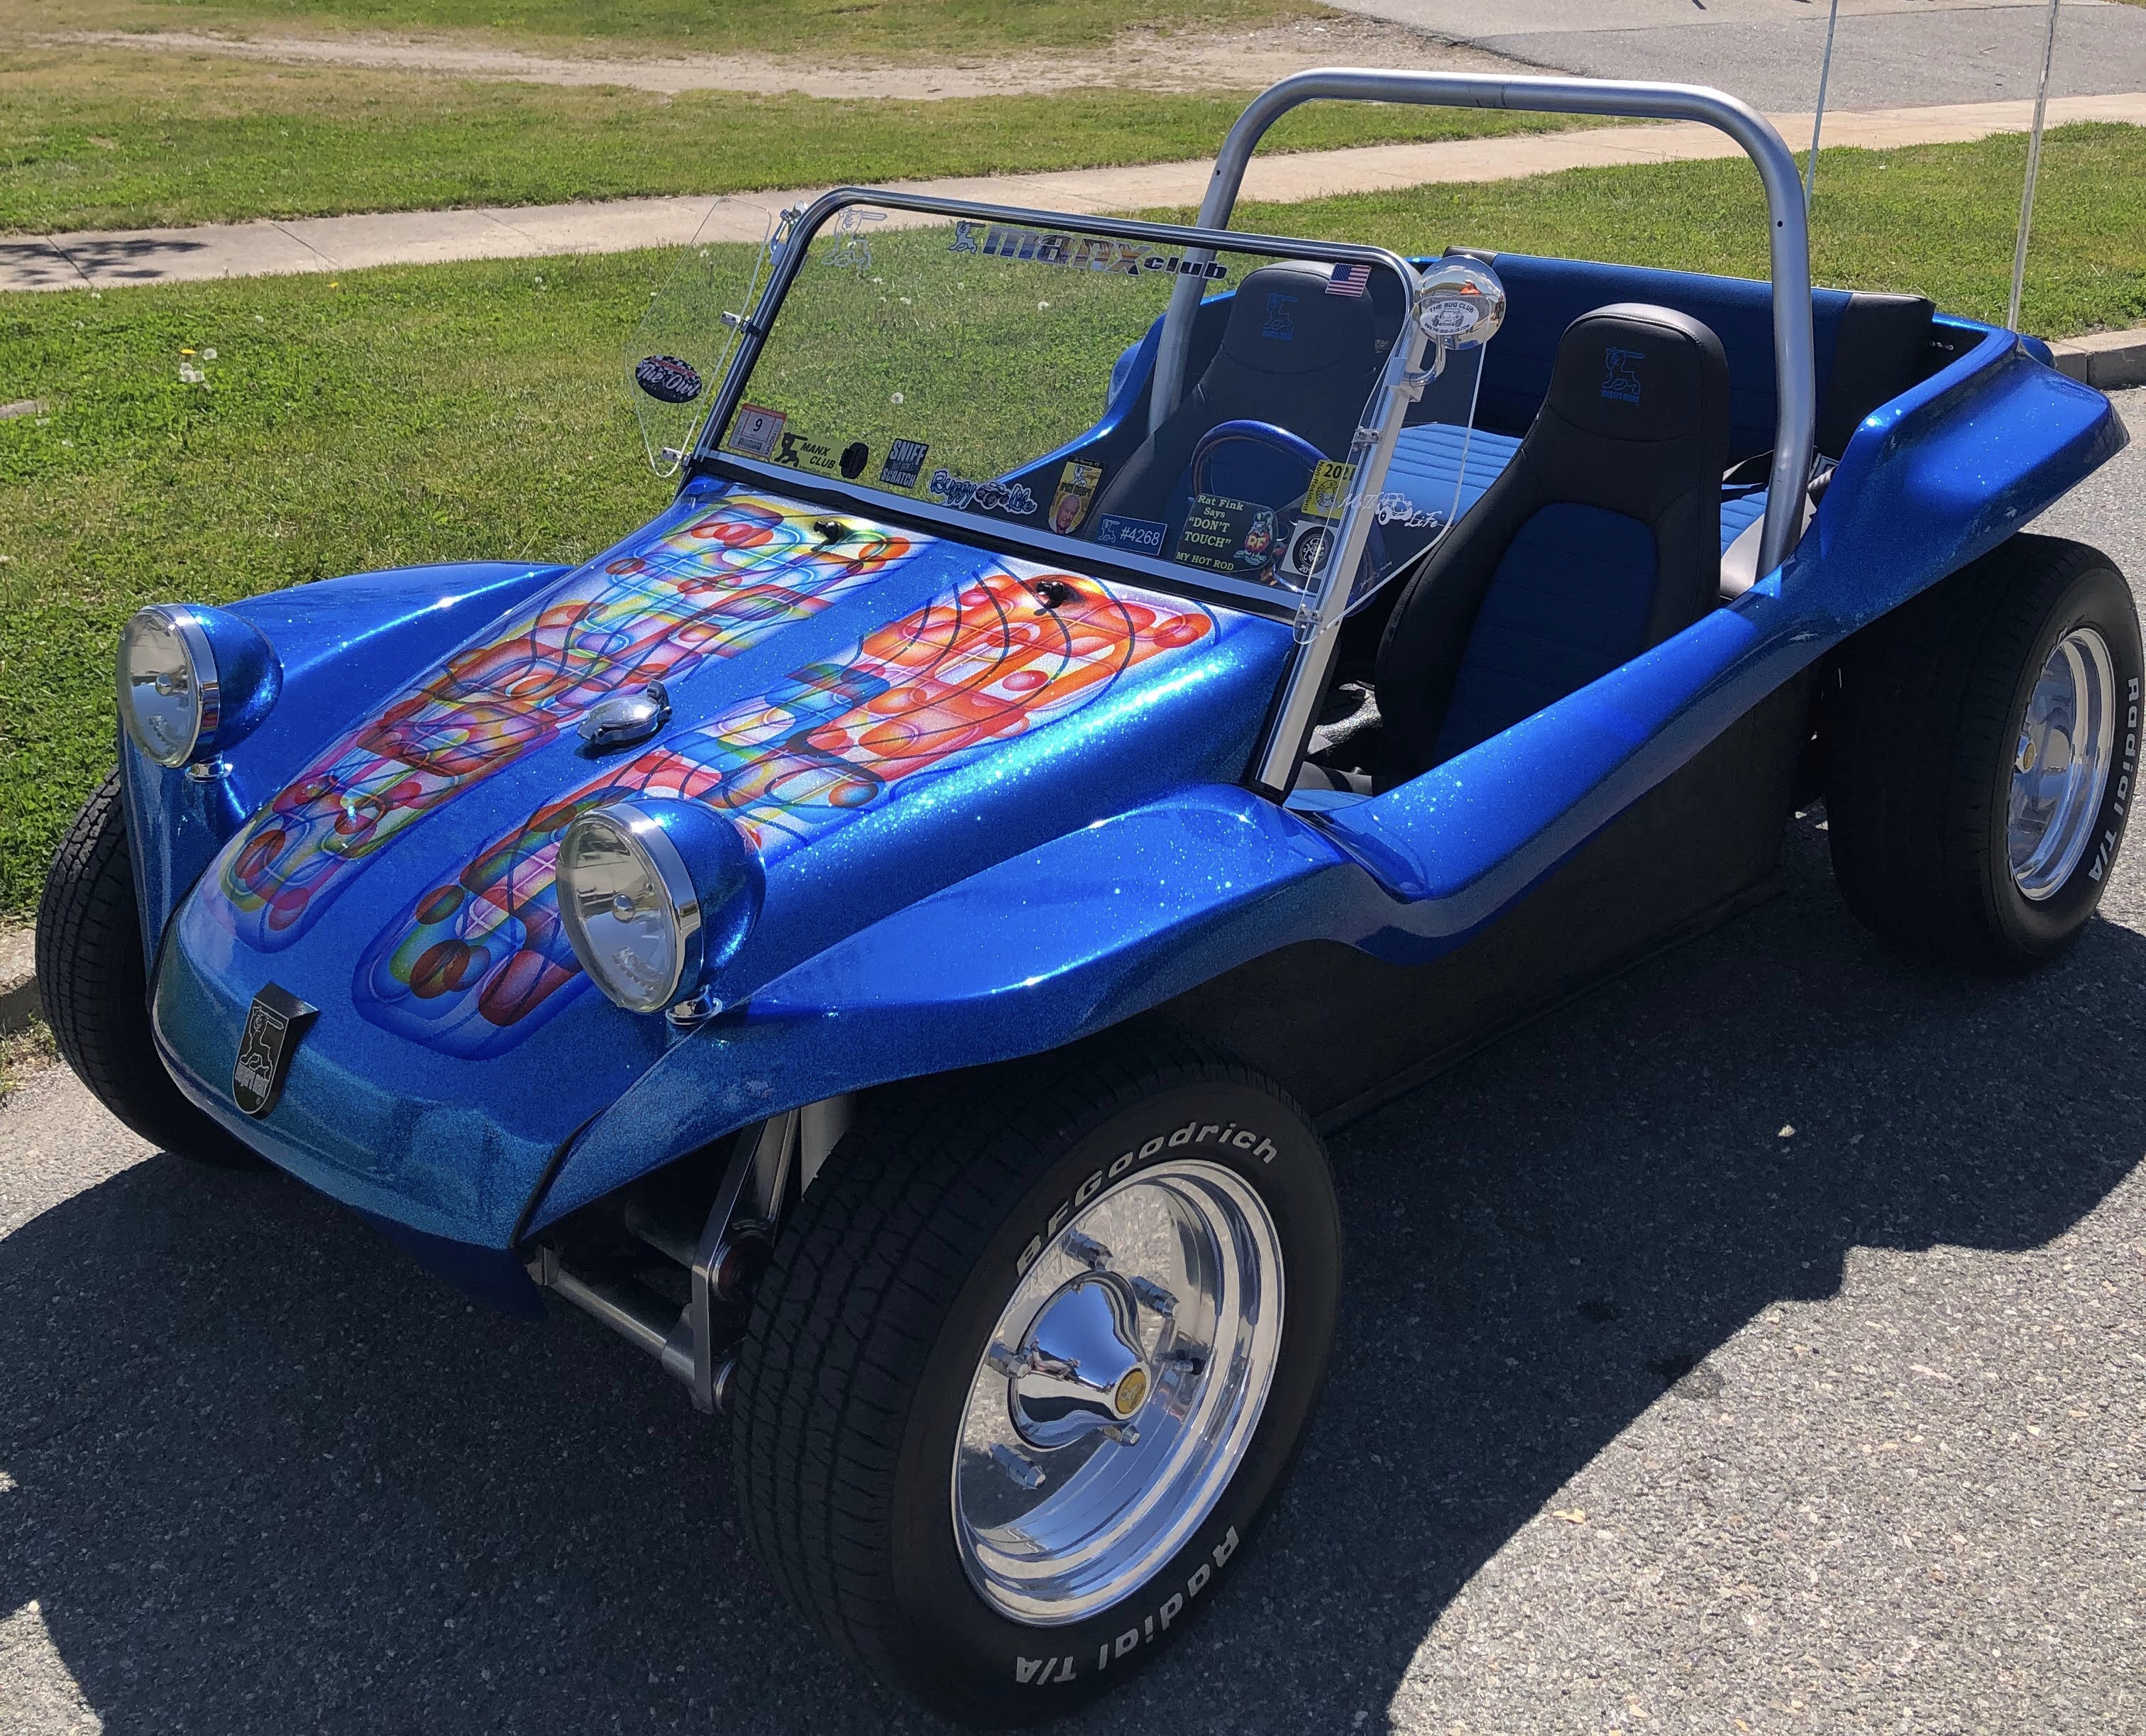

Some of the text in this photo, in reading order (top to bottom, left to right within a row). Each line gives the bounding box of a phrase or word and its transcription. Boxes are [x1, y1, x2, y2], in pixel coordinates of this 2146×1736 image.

[982, 225, 1228, 280] manx club
[1429, 304, 1442, 312] THE
[1459, 302, 1475, 313] CLUB
[637, 363, 664, 383] The
[665, 374, 701, 397] Owl
[753, 418, 763, 432] 9
[800, 442, 831, 456] MANX
[889, 439, 927, 466] SNIFF
[809, 456, 836, 469] CLUB
[881, 468, 917, 488] SCRATCH
[930, 469, 977, 509] Buggy
[1197, 495, 1244, 511] Rat Fink
[1203, 507, 1226, 519] Says
[1189, 516, 1231, 533] “DON’T
[1119, 526, 1160, 546] #4268
[1184, 531, 1232, 548] TOUCH”
[1175, 551, 1234, 571] MY HOT ROD
[2088, 676, 2140, 881] Radial T/A
[1016, 1121, 1277, 1278] BFGoodrich
[1016, 1525, 1240, 1686] Radial T/A
